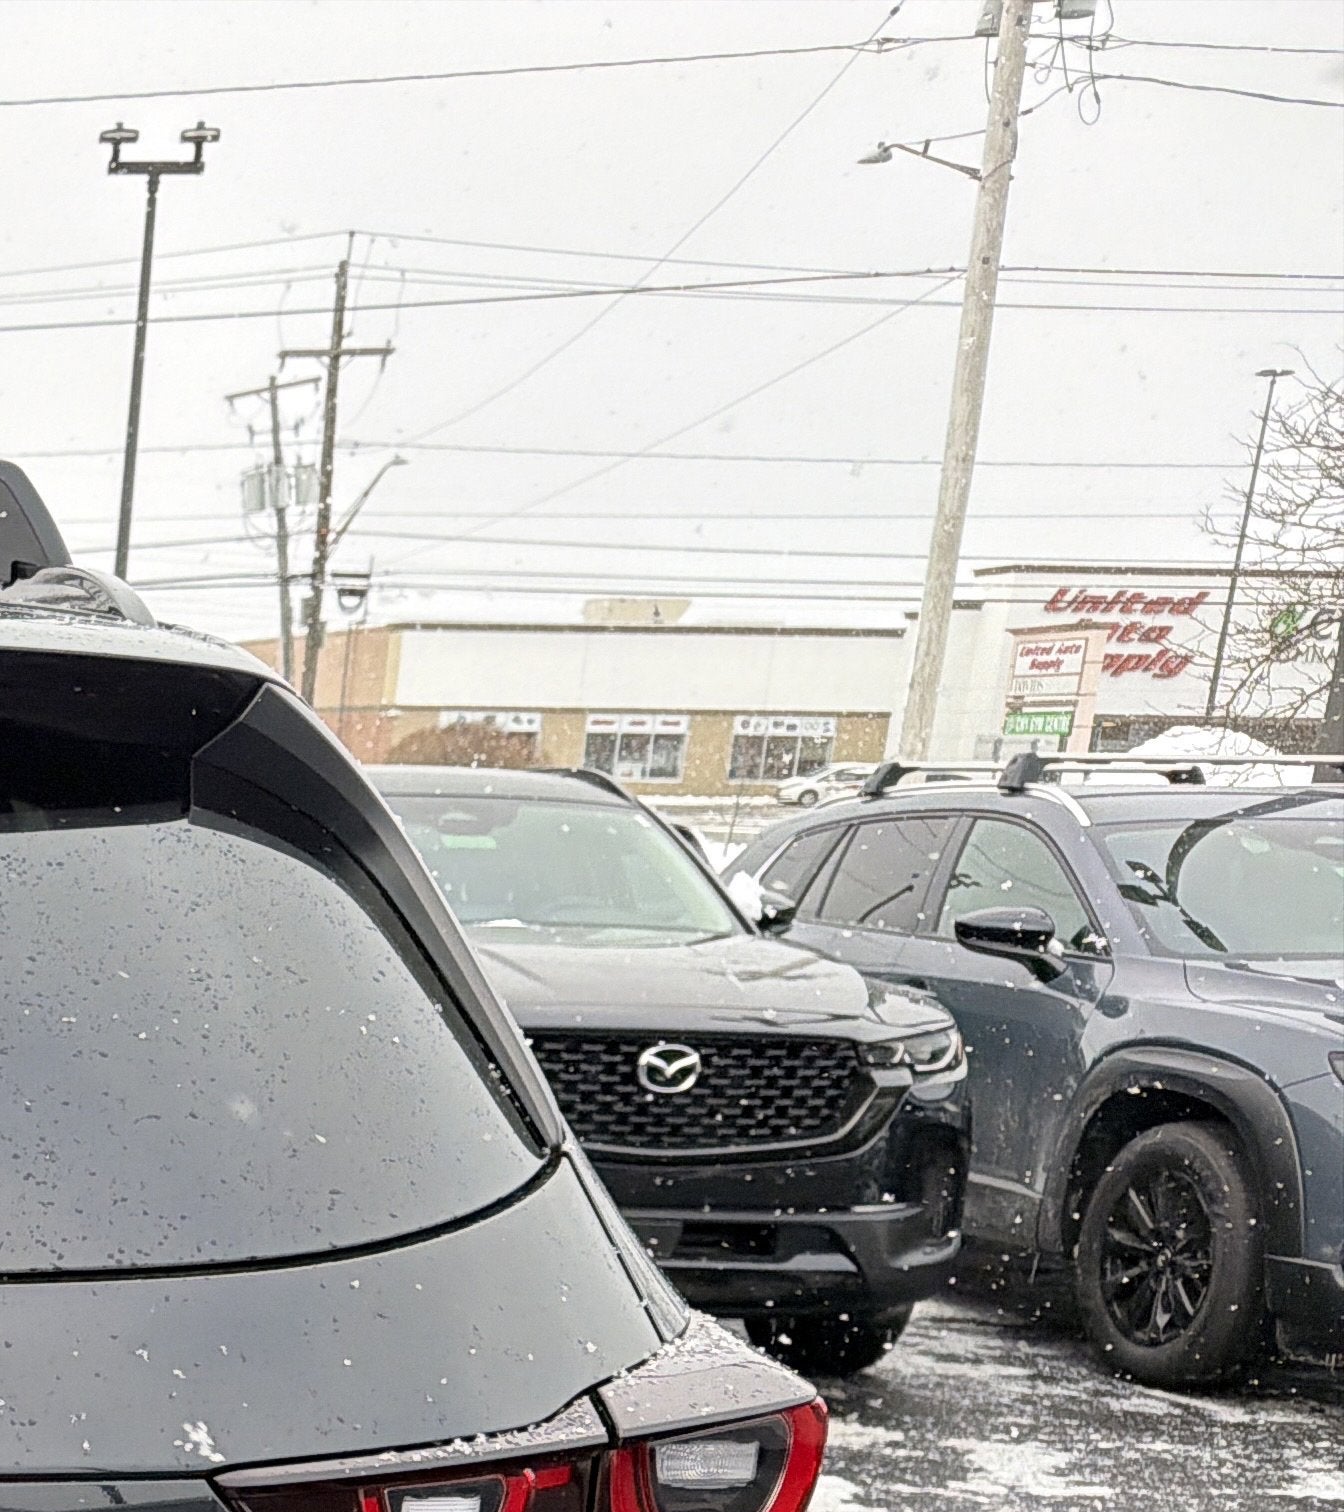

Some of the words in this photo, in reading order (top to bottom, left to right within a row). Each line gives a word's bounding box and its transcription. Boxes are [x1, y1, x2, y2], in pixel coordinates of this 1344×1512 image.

[1044, 587, 1210, 615] United
[1106, 621, 1173, 643] to
[1102, 649, 1195, 679] pply
